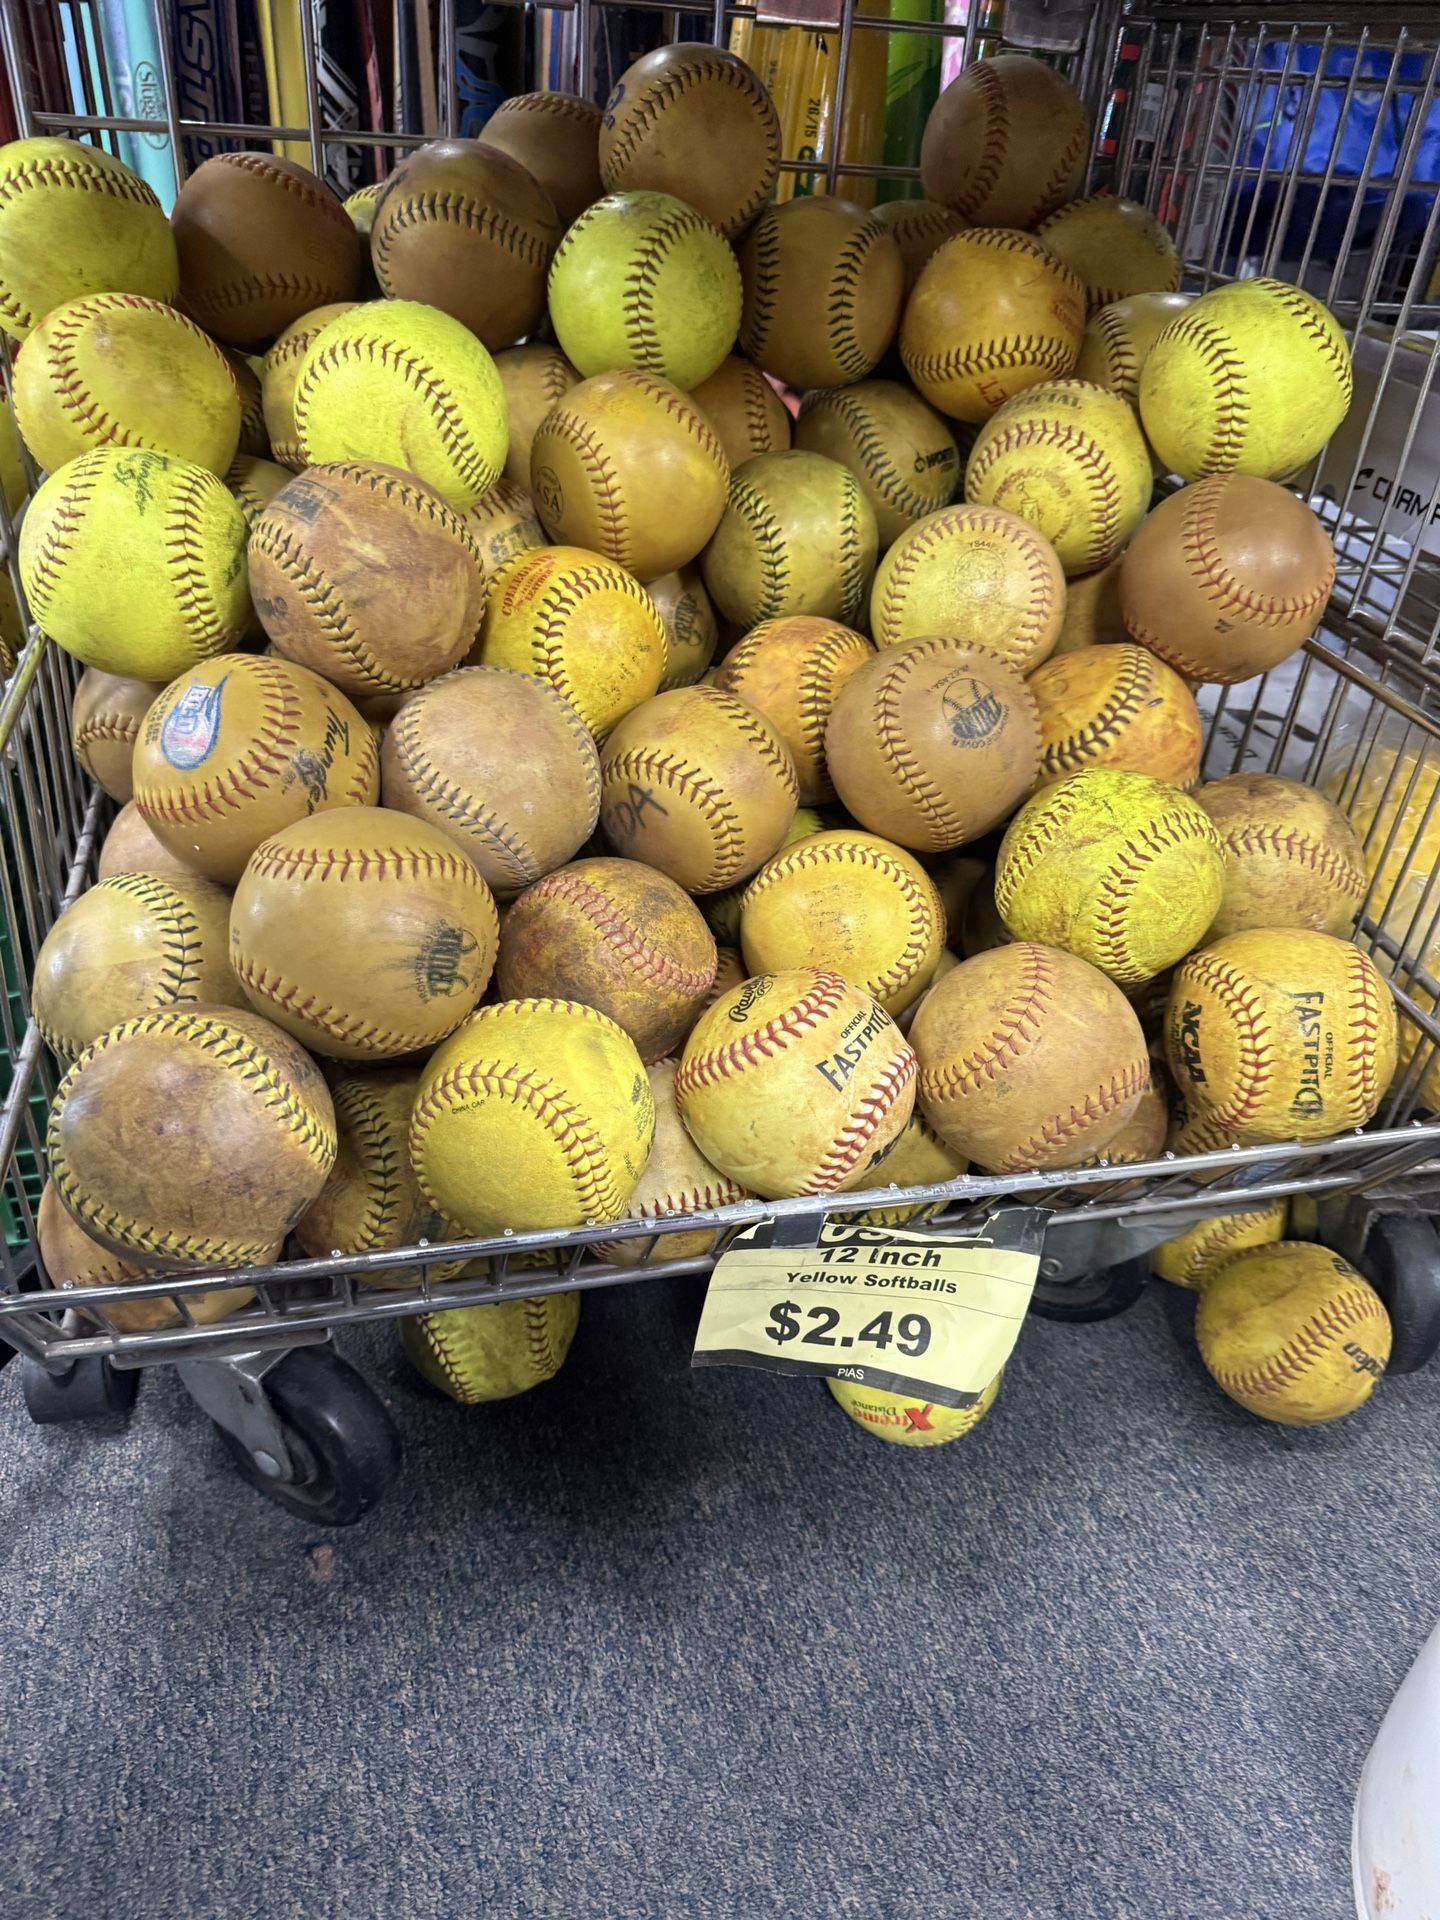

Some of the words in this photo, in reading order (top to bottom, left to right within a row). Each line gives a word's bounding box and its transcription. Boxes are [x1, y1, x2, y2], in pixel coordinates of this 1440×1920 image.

[840, 1010, 867, 1040] OFFICIAL
[1181, 1000, 1208, 1084] NCAA
[1324, 1031, 1334, 1080] OFFICIAL
[819, 1247, 860, 1264] 12
[869, 1247, 942, 1268] Inch
[786, 1271, 859, 1286] Yellow
[863, 1273, 958, 1294] Softballs
[764, 1300, 932, 1358] $2.49
[836, 1367, 866, 1381] PIAS
